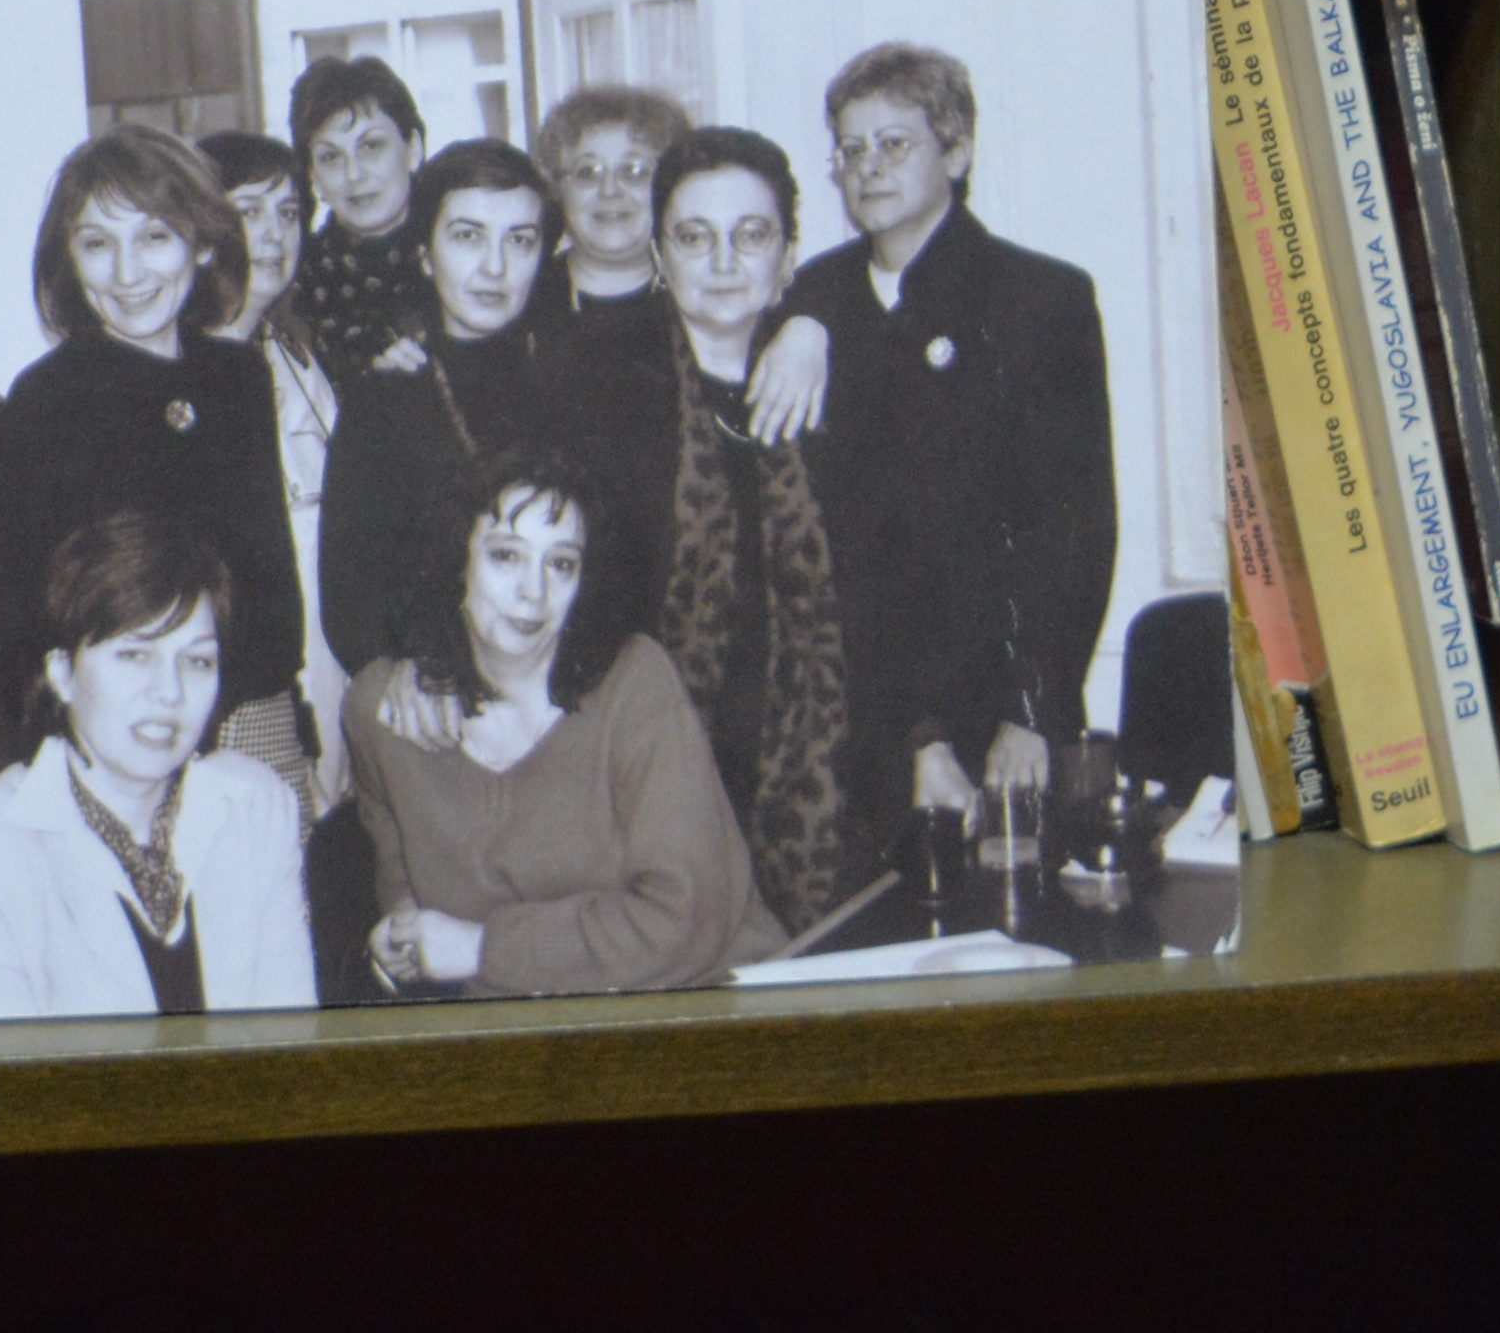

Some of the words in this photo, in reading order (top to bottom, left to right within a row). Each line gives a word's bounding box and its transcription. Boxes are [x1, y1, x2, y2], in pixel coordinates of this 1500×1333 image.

[1231, 20, 1255, 45] la
[1238, 53, 1265, 88] de
[1220, 92, 1245, 126] Le
[1333, 85, 1366, 146] THE
[1231, 140, 1265, 219] Lacan
[1250, 96, 1308, 282] fondamentaux
[1347, 157, 1381, 223] AND
[1249, 225, 1292, 333] Jacques
[1292, 288, 1338, 407] concepts
[1362, 235, 1422, 430] YUGOSLAVIA
[1321, 413, 1360, 498] quatre
[1339, 506, 1369, 554] Les
[1451, 680, 1479, 719] EU
[1370, 776, 1432, 813] Seuil
